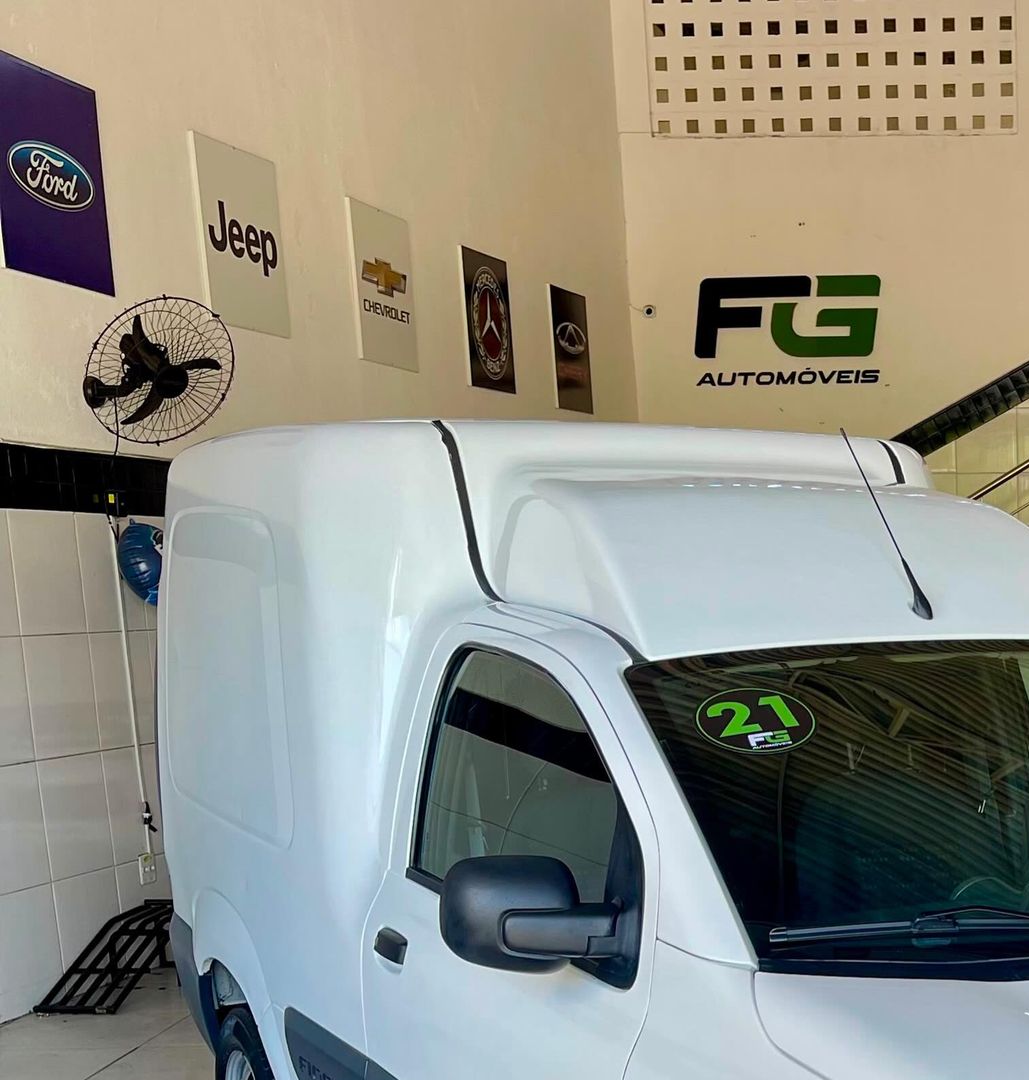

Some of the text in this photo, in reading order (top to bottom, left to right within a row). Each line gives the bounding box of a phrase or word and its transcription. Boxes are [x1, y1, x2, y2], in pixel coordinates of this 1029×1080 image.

[26, 150, 79, 202] Ford
[208, 200, 278, 277] Jeep
[363, 298, 411, 325] CHEVROLET
[694, 274, 882, 359] FG
[696, 367, 881, 387] AUTOMÓVEIS
[706, 695, 800, 738] 21
[747, 730, 791, 747] FG
